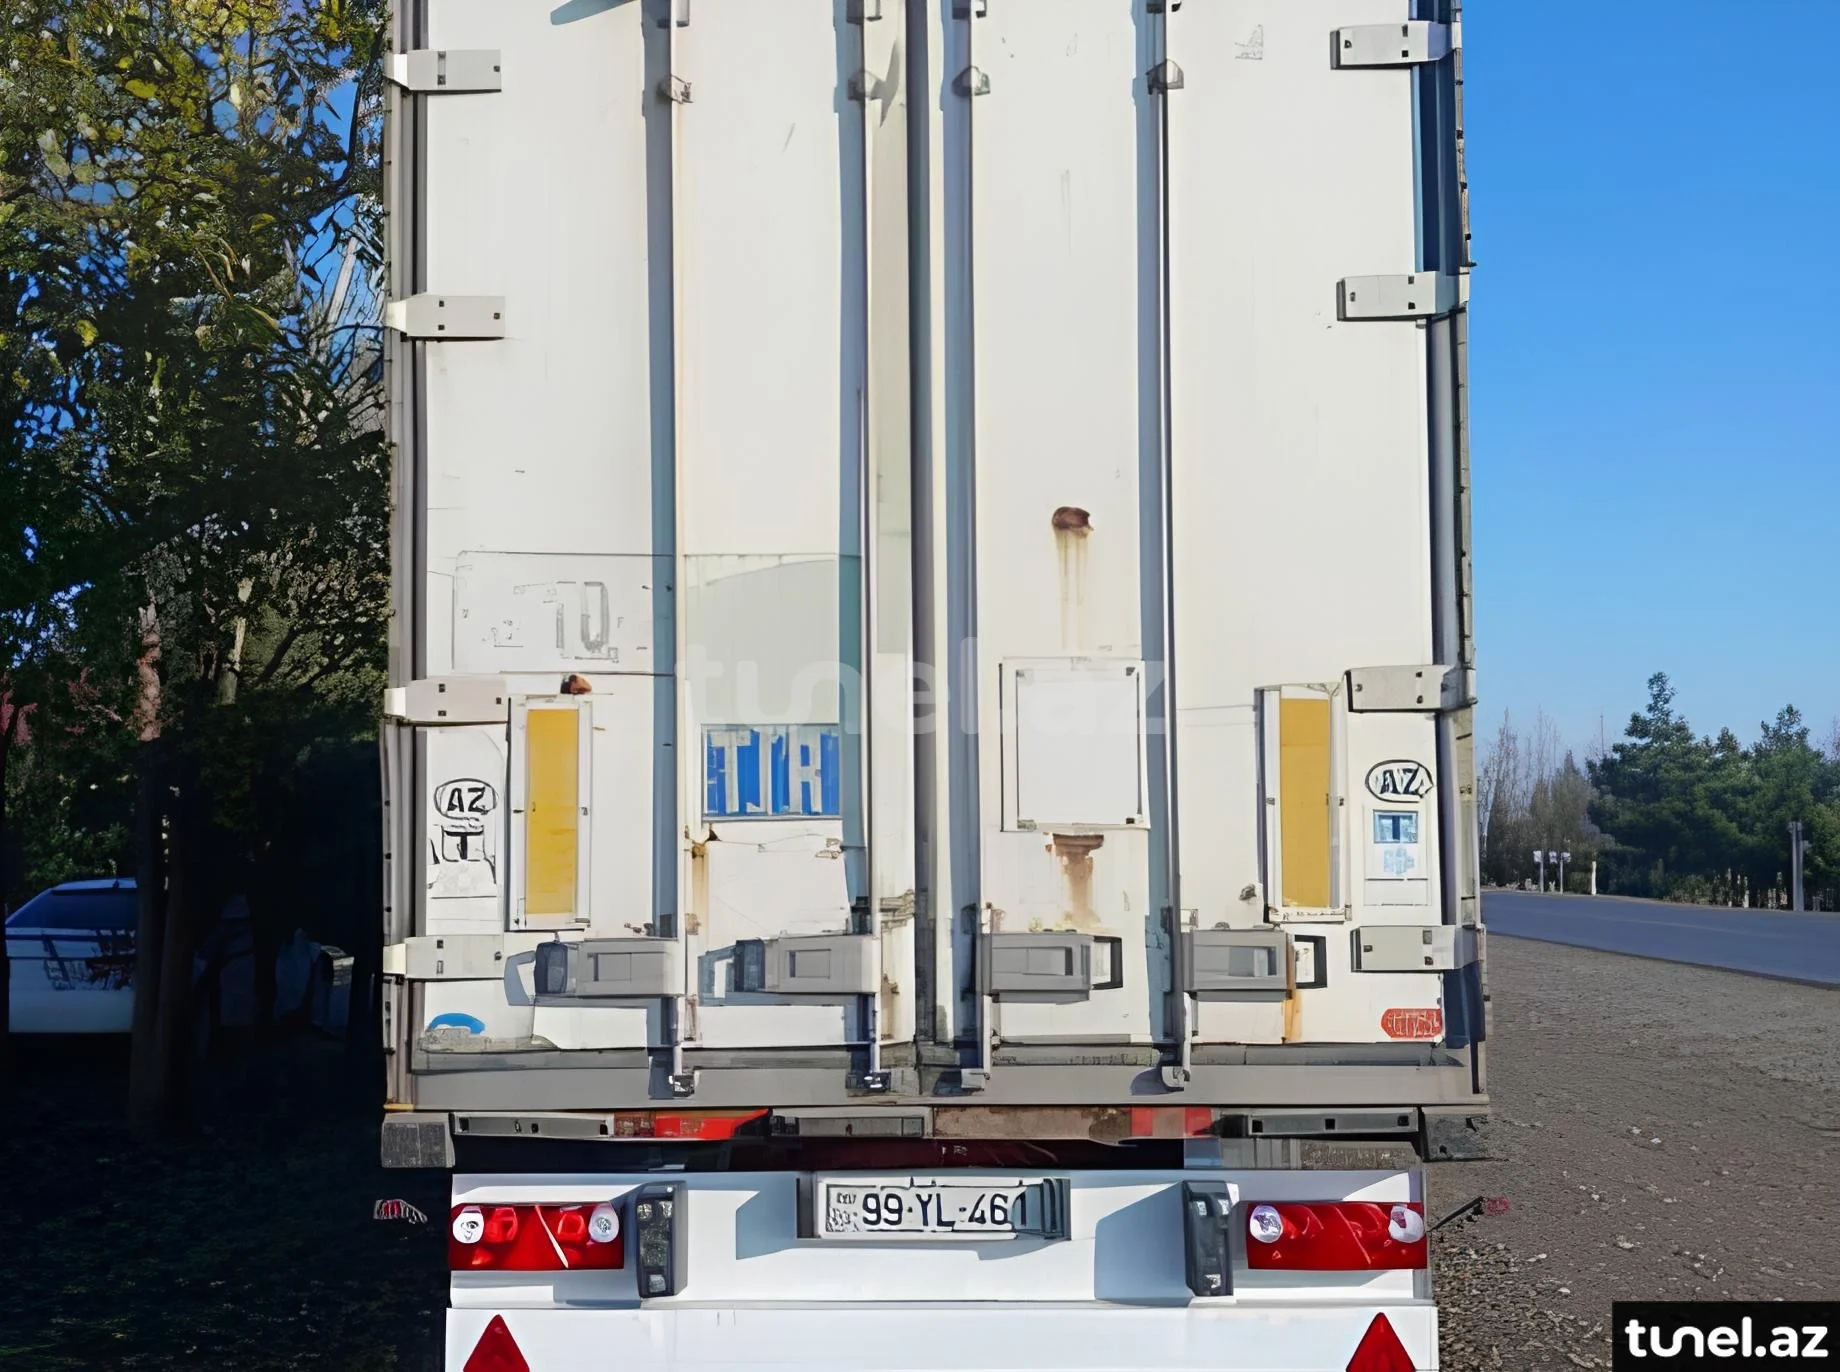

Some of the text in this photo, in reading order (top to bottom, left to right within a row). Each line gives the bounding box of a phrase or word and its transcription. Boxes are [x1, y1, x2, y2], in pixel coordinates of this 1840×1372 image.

[710, 727, 821, 815] TIR
[1380, 766, 1422, 796] AZ
[446, 786, 489, 814] AZ
[444, 830, 484, 860] T
